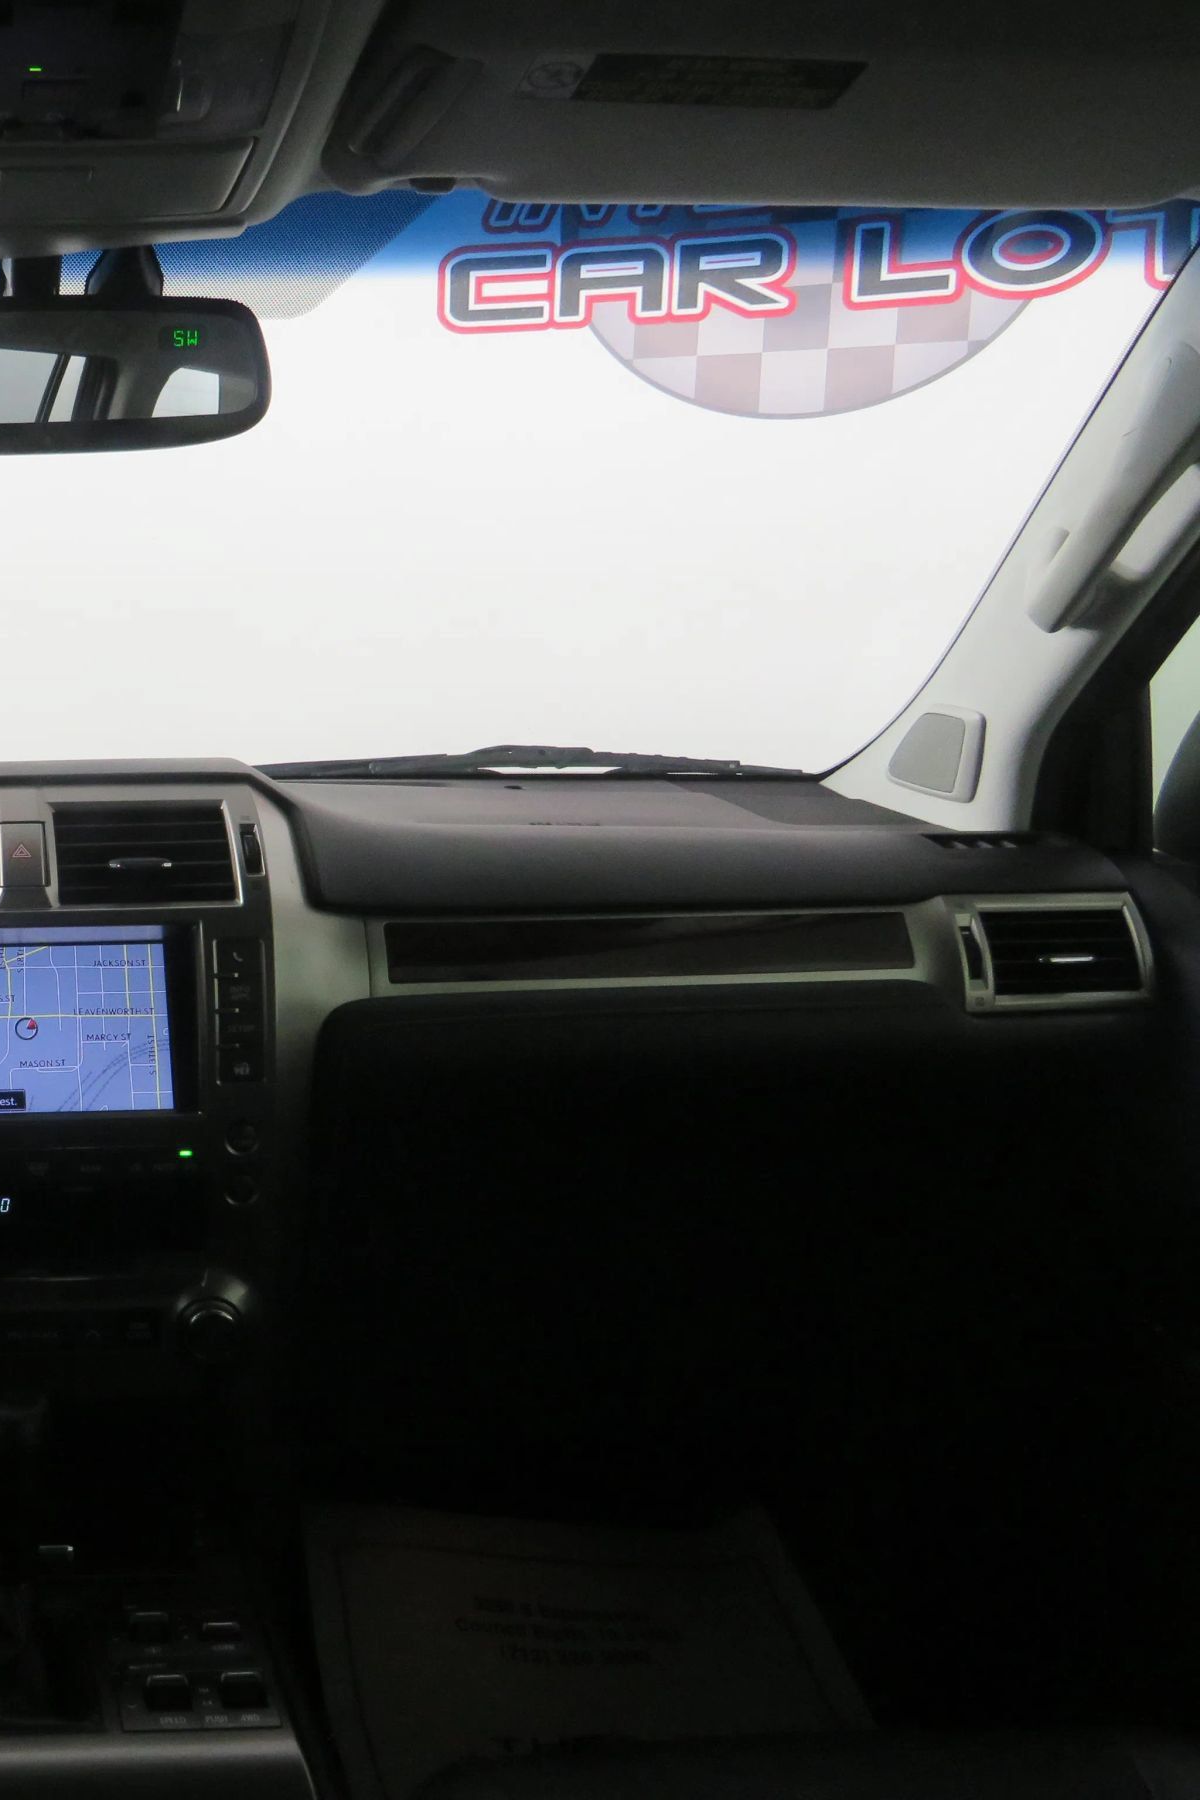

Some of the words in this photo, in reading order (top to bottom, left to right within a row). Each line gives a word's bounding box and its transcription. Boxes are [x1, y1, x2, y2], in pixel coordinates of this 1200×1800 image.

[440, 229, 795, 333] CAR
[843, 208, 1200, 312] LOT
[173, 330, 198, 347] SW
[73, 1007, 142, 1015] LEAVENWORTH
[143, 1007, 154, 1015] ST
[86, 1033, 118, 1041] MARCY
[19, 1060, 53, 1068] MASON
[55, 1059, 66, 1067] ST
